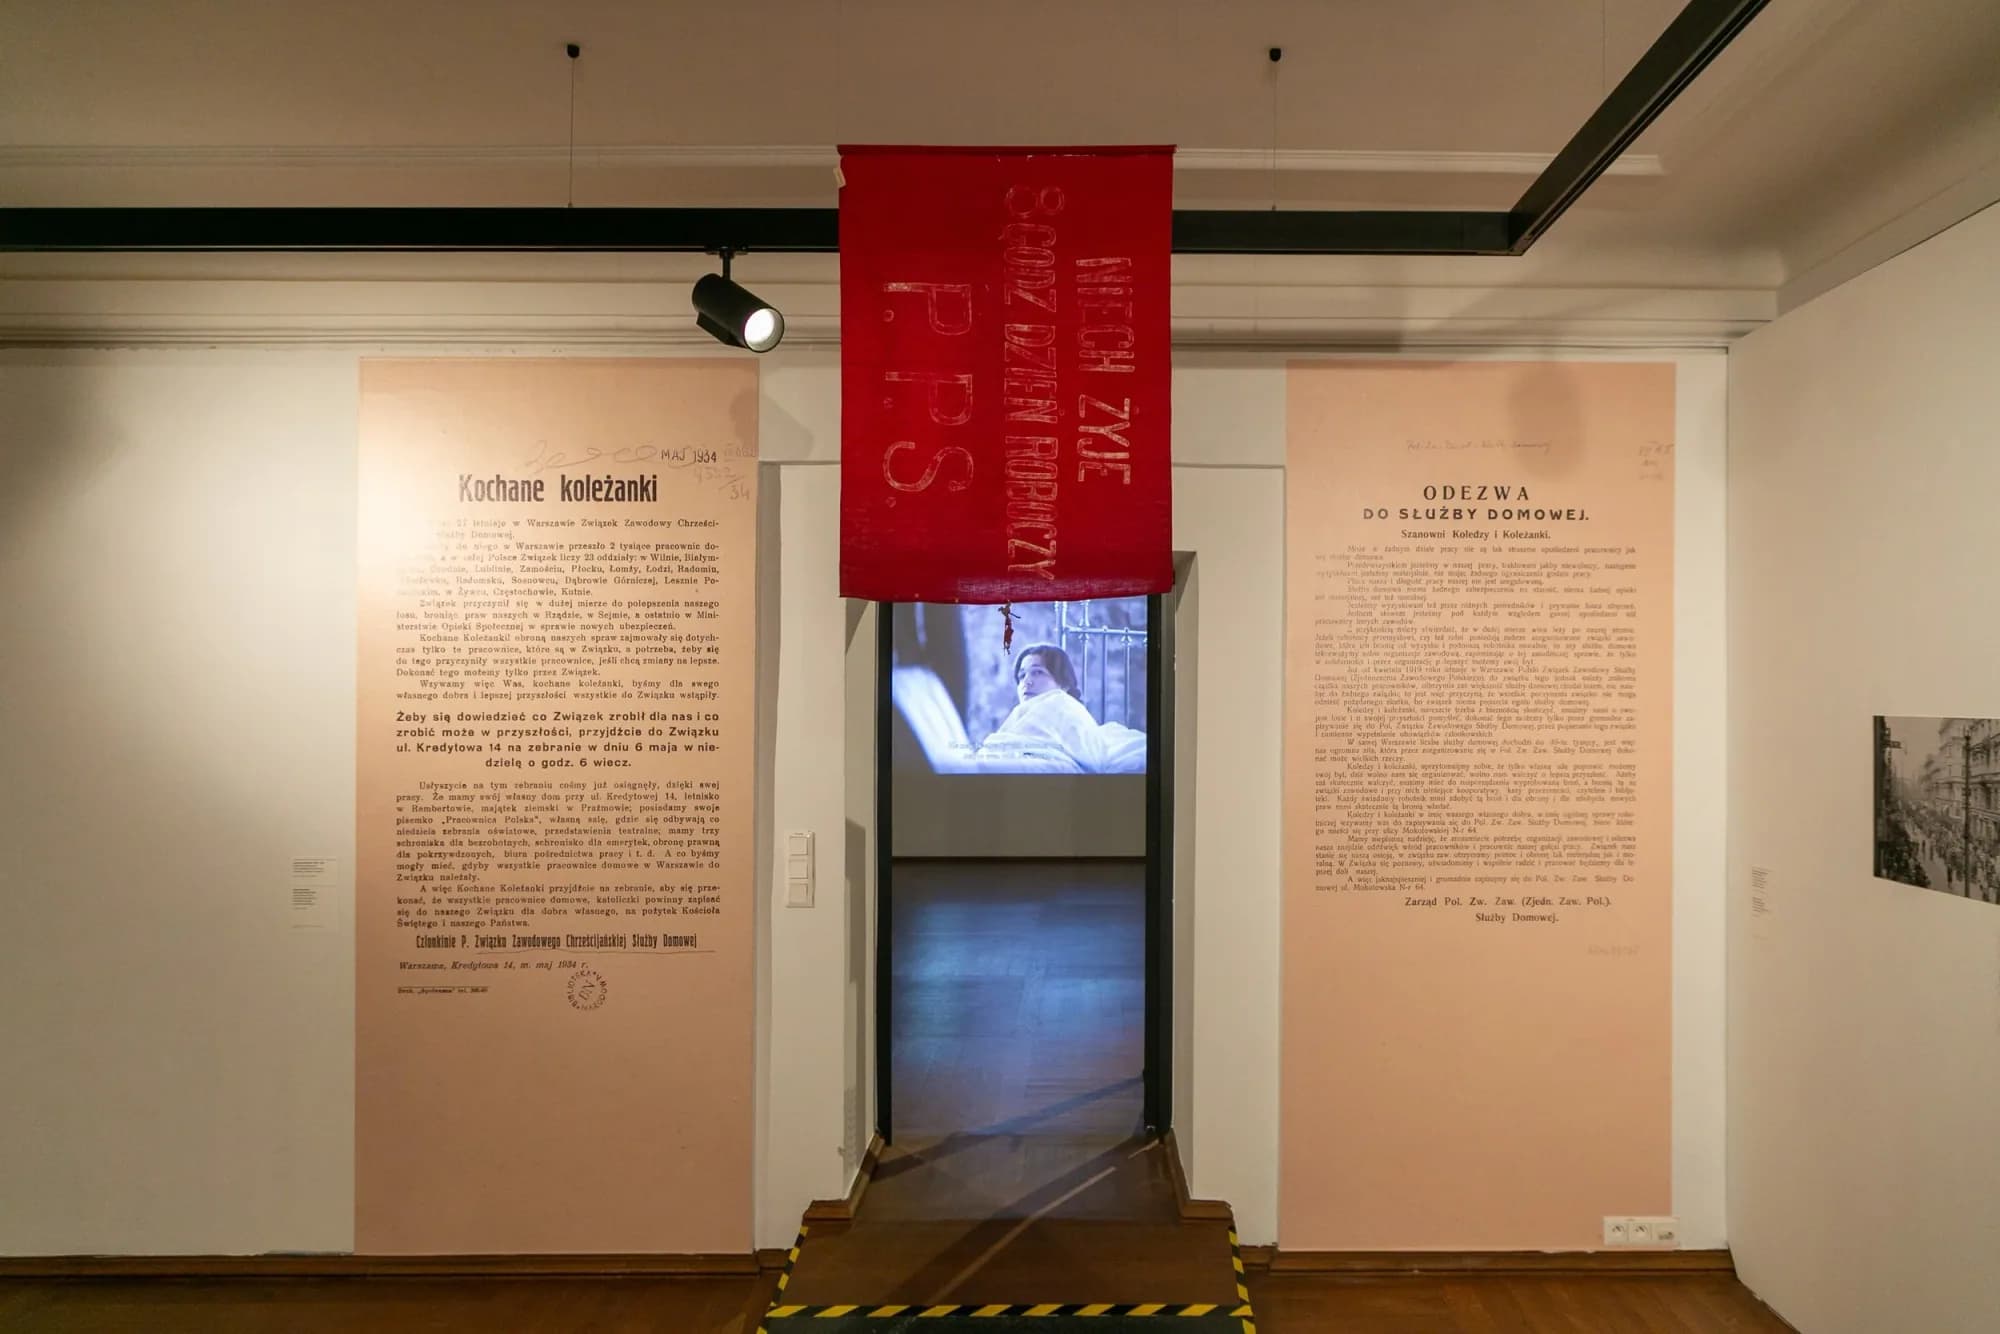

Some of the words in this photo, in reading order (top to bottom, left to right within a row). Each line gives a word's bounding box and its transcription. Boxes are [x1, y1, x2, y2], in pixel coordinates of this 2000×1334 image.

[1075, 257, 1136, 374] NIECH
[1076, 394, 1140, 484] ŻYJE
[694, 450, 717, 463] 1934
[459, 474, 544, 502] Kochane
[560, 474, 657, 502] koleżanki
[1423, 486, 1528, 500] ODEZWA
[1005, 436, 1059, 580] ROBOCZY
[1363, 508, 1388, 520] DO
[1399, 506, 1476, 520] SŁUŻBY
[1488, 509, 1589, 520] DOMOWEJ.
[527, 519, 575, 527] Warszawie
[581, 519, 618, 528] Związek
[624, 519, 671, 528] Zawodowy
[677, 519, 718, 527] Chrześci-
[1401, 529, 1445, 538] Szanowni
[1452, 530, 1489, 541] Koledzy
[1494, 530, 1498, 539] i
[1502, 530, 1550, 539] Koleżanki.
[516, 542, 564, 550] Warszawie
[568, 542, 606, 552] przeszło
[610, 542, 615, 550] 2
[619, 543, 651, 551] tysiące
[655, 544, 700, 552] pracownic
[704, 542, 718, 550] do-
[396, 711, 426, 724] Żeby
[433, 712, 451, 723] się
[457, 712, 526, 721] dowiedzieć
[553, 711, 603, 723] Związek
[609, 712, 645, 721] zrobił
[649, 712, 667, 721] dla
[696, 712, 700, 721] i
[396, 727, 435, 737] zrobić
[442, 728, 475, 737] może
[496, 727, 571, 739] przyszłości,
[578, 727, 642, 738] przyjdźcie
[648, 727, 663, 736] do
[669, 726, 719, 738] Związku
[396, 743, 410, 752] ul.
[416, 742, 482, 754] Kredytowa
[490, 743, 501, 752] 14
[528, 742, 581, 752] zebranie
[603, 742, 629, 751] dniu
[635, 742, 643, 752] 6
[648, 742, 677, 753] maja
[698, 742, 719, 752] nie-
[485, 758, 522, 769] dzielę
[541, 758, 573, 769] godz.
[579, 758, 587, 767] 6
[593, 757, 631, 767] wiecz.
[497, 861, 540, 871] wszystkie
[546, 861, 597, 871] pracownice
[601, 861, 639, 869] domowe
[656, 861, 704, 869] Warszawie
[1405, 897, 1437, 907] Zarząd
[1444, 897, 1462, 906] Pol.
[1469, 897, 1486, 906] Zw.
[1495, 897, 1517, 905] Zaw.
[1521, 897, 1554, 908] (Zjedn.
[1559, 897, 1581, 905] Zaw.
[1586, 896, 1612, 907] Pol.).
[1475, 913, 1505, 924] Służby
[1512, 913, 1558, 924] Domowej.
[416, 935, 456, 948] Członkinie
[461, 934, 469, 948] P.
[474, 934, 507, 949] Związku
[512, 934, 561, 949] Zawodowego
[566, 934, 627, 949] Chrześcijańskiej
[632, 934, 658, 949] Służby
[663, 933, 697, 948] Domowej
